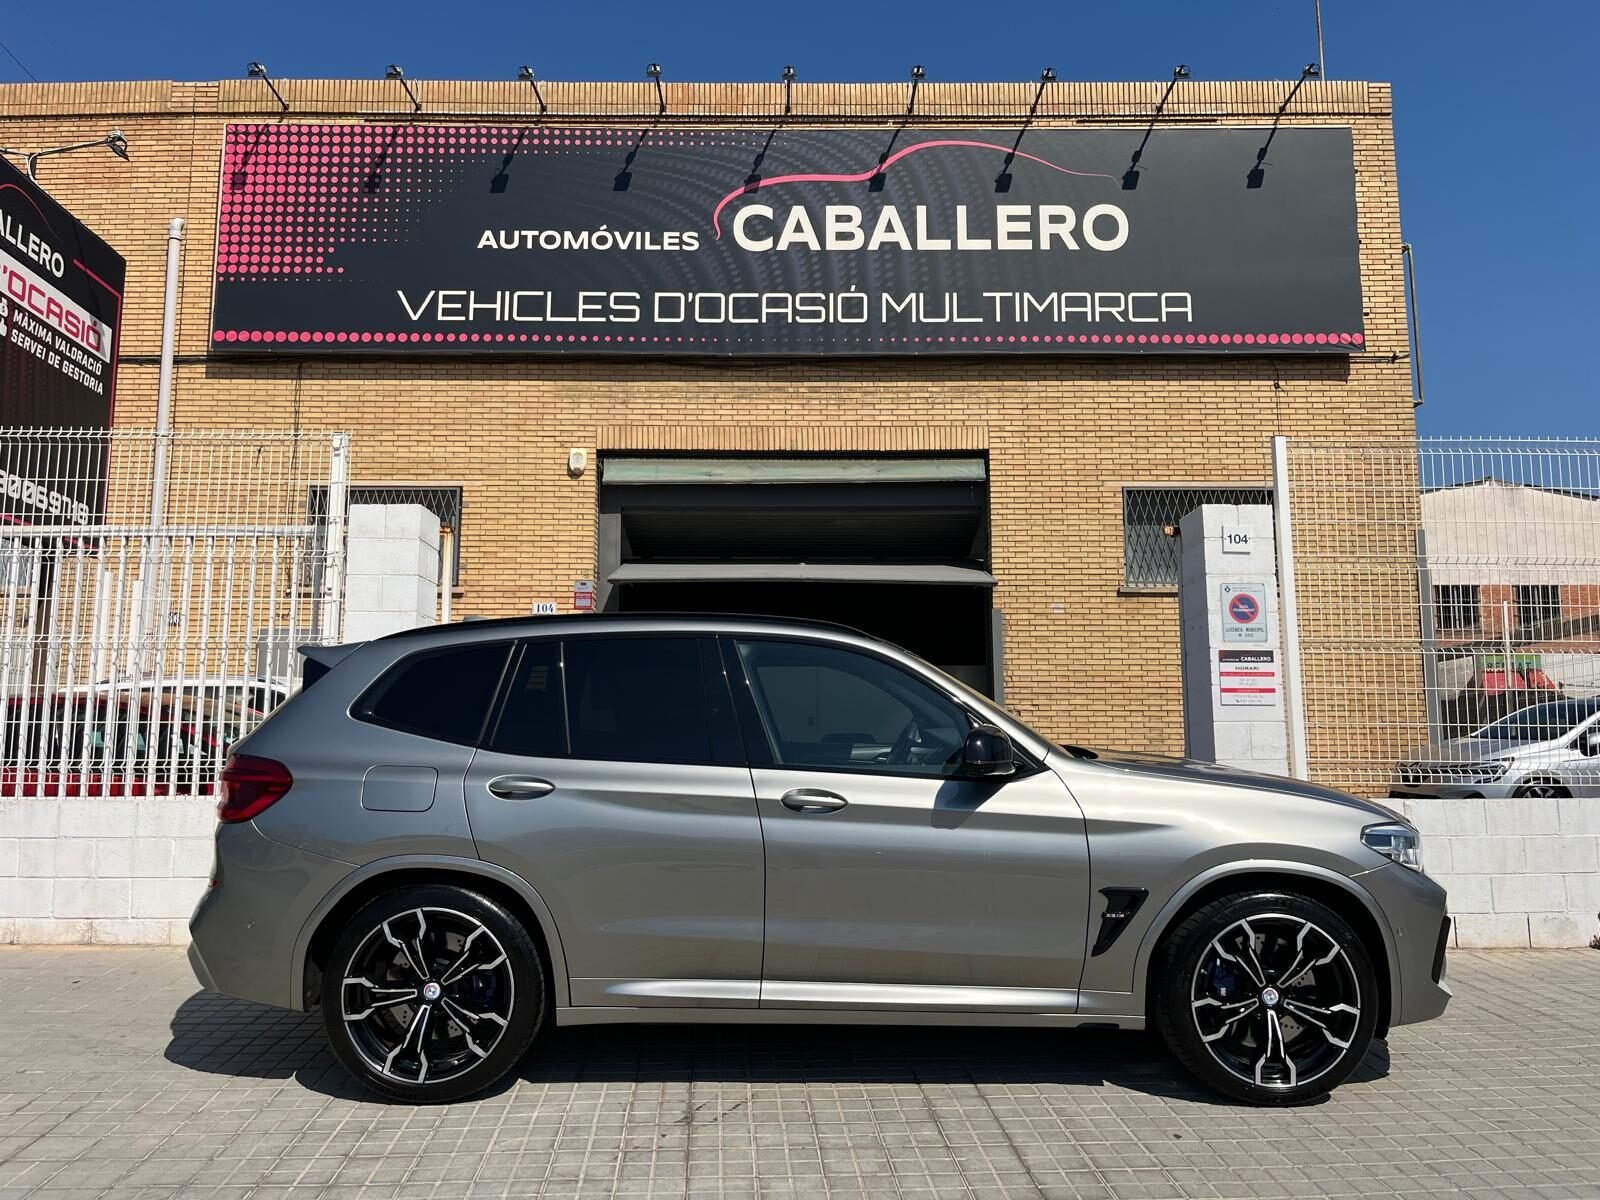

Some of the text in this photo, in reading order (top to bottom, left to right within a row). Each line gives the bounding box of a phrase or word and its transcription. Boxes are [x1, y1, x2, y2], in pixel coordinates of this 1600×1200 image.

[477, 204, 1130, 252] AUTOMÓVILES CABALLERO
[397, 290, 641, 322] VEHICLES
[653, 284, 869, 324] D'OCASIÓ
[10, 328, 104, 396] SERVEI DE GESTORIA
[55, 335, 103, 376] VALORACIÓ
[1226, 533, 1249, 545] 104
[535, 603, 554, 614] 104
